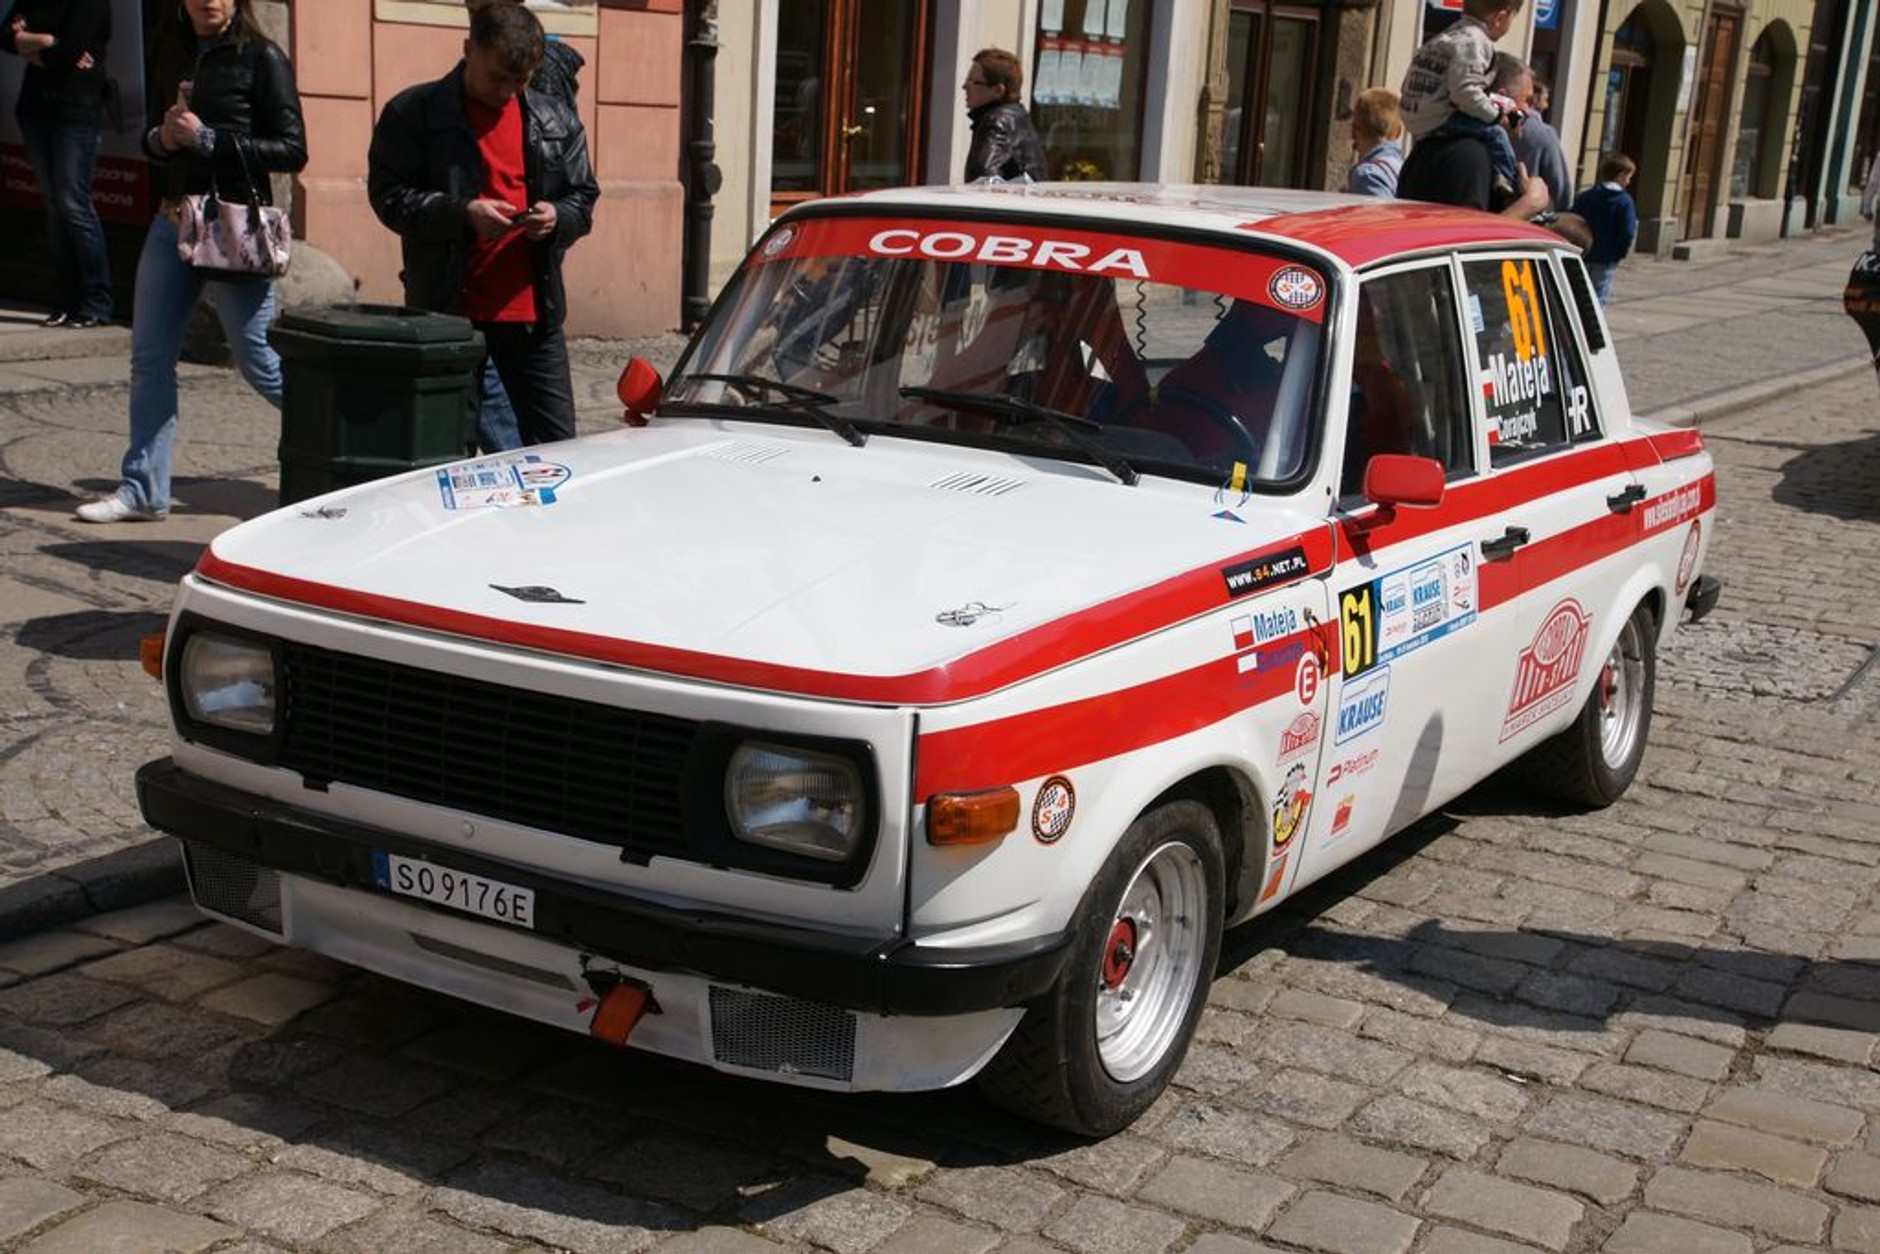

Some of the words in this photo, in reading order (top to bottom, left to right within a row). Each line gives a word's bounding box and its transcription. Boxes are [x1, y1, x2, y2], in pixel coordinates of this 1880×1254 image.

[869, 230, 1150, 278] COBRA
[1502, 259, 1546, 364] 61
[1489, 346, 1550, 408] Mateja
[1254, 606, 1298, 642] Mateja
[1342, 588, 1373, 674] 61
[1302, 665, 1315, 699] E
[1338, 690, 1385, 736] KRAUSE
